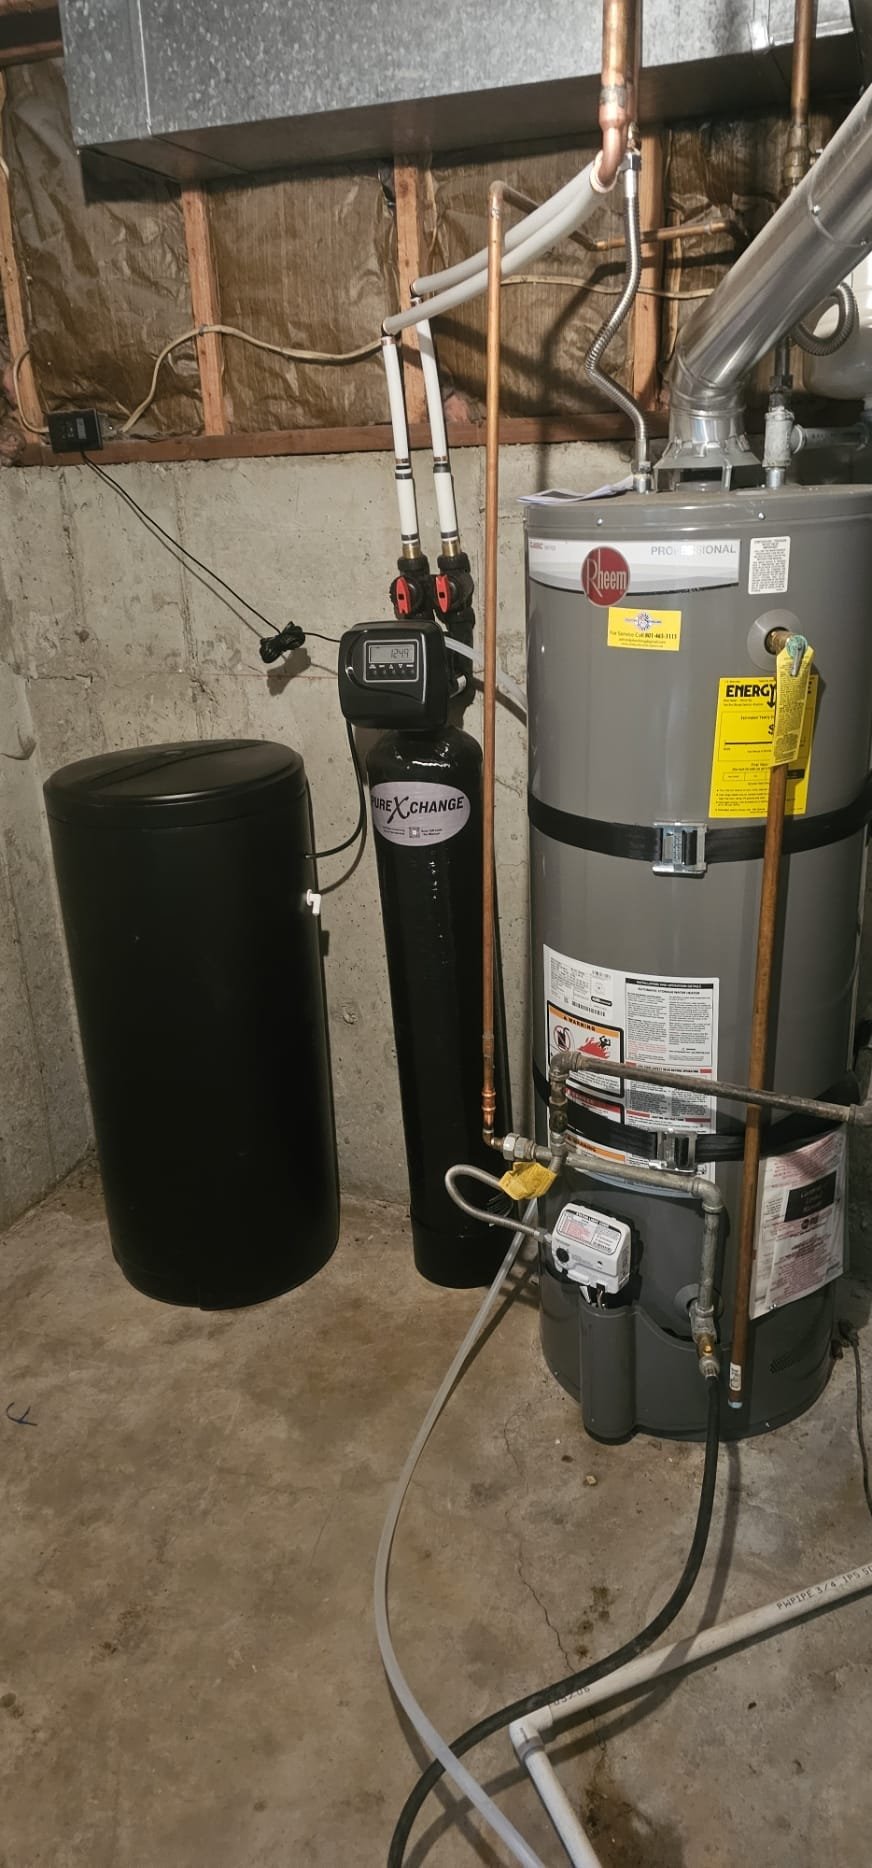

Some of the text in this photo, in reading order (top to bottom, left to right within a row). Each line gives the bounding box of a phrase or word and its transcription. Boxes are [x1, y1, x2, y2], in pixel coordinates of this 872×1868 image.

[650, 543, 737, 556] PROIONAL
[586, 548, 627, 598] Rheem
[568, 1017, 596, 1032] WARNING
